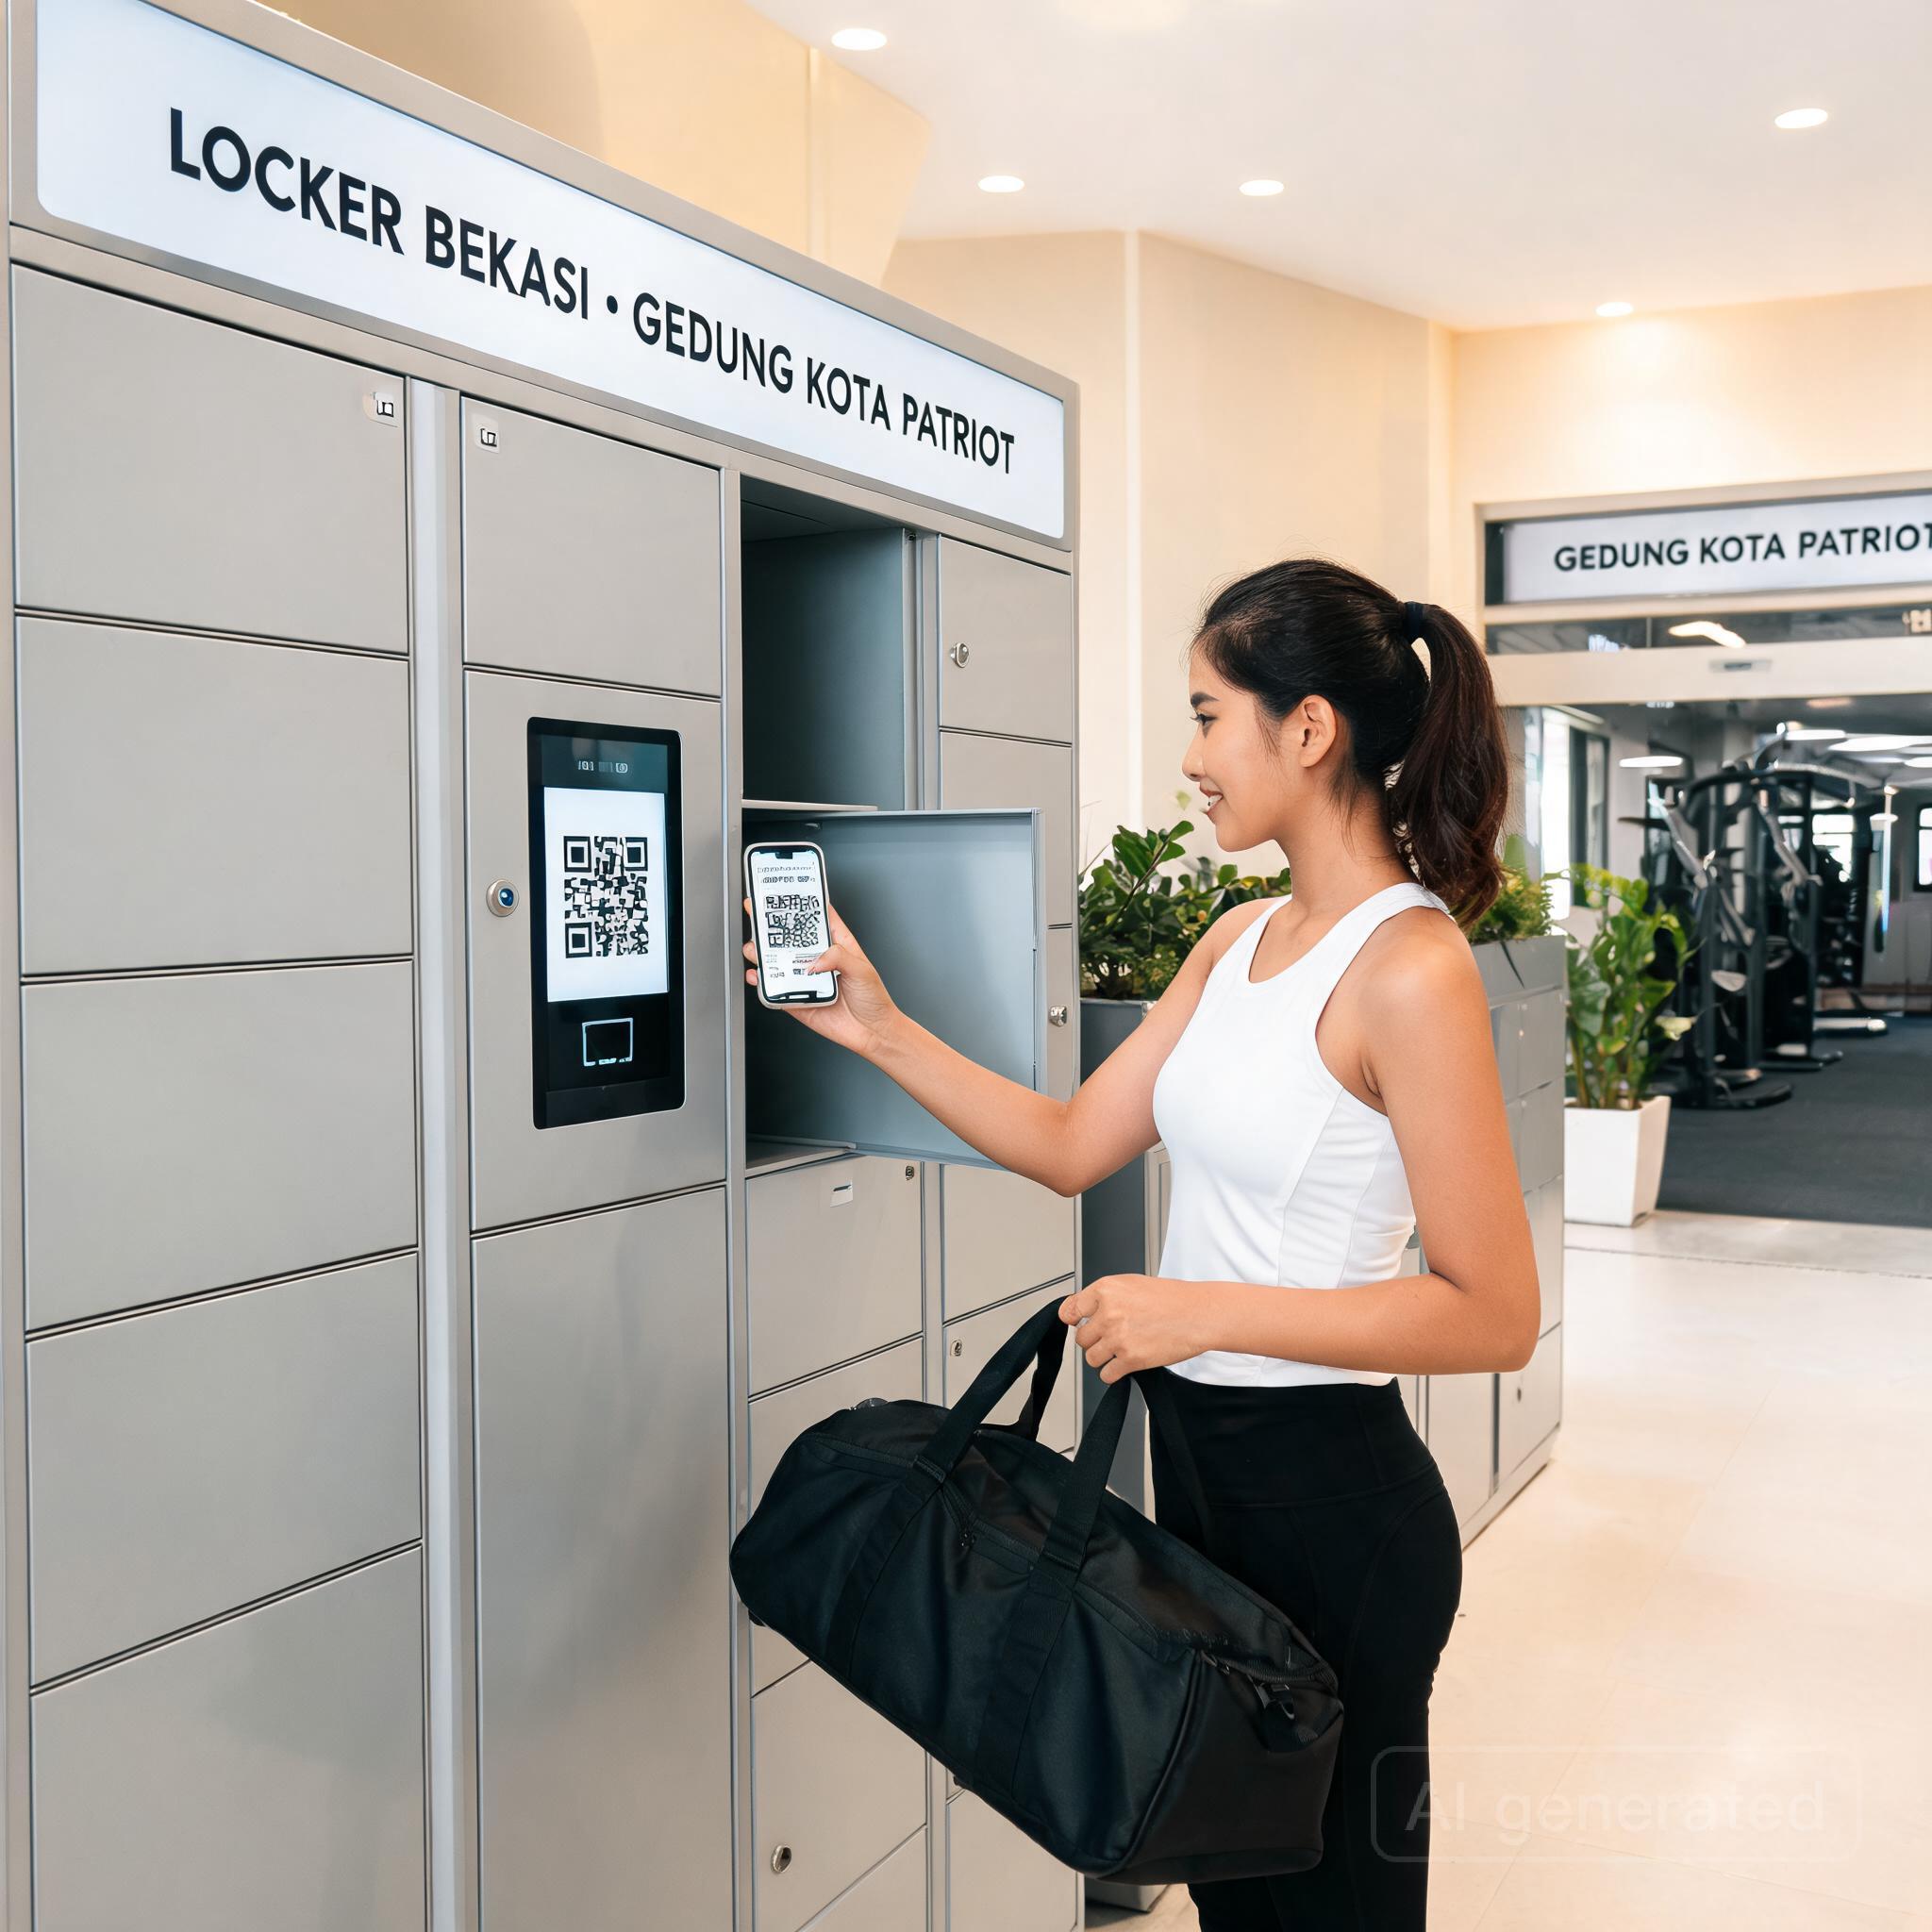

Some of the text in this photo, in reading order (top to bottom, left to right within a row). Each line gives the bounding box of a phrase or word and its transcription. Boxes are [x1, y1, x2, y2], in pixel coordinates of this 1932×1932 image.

[170, 107, 405, 256] LOCKER
[425, 205, 590, 321] BEKASI
[633, 291, 794, 394] GEDUNG
[807, 357, 891, 431] KOTA
[903, 392, 1016, 475] PATRIOT
[1554, 539, 1689, 572] GEDUNG
[1700, 533, 1786, 564] KOTA
